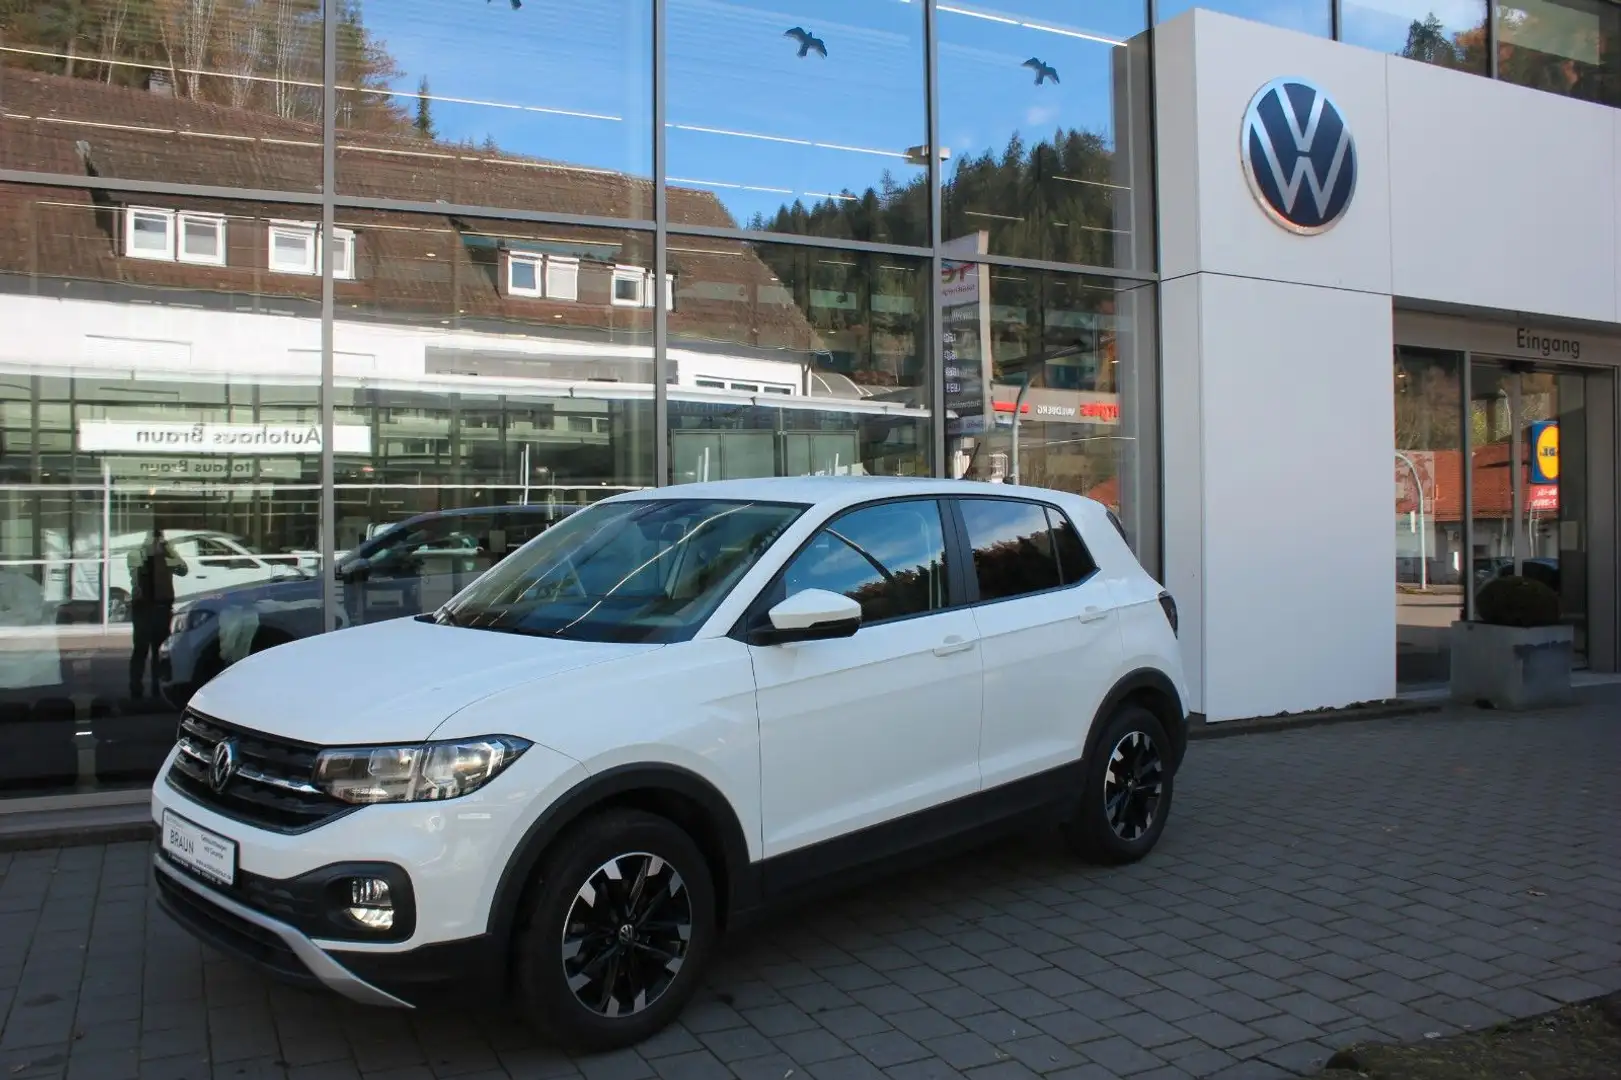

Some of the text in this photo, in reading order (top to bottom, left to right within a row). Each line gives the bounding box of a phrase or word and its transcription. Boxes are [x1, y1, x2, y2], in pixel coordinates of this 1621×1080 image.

[1243, 78, 1355, 230] VW
[1516, 327, 1580, 359] Eingang
[170, 828, 194, 855] BRAUN
